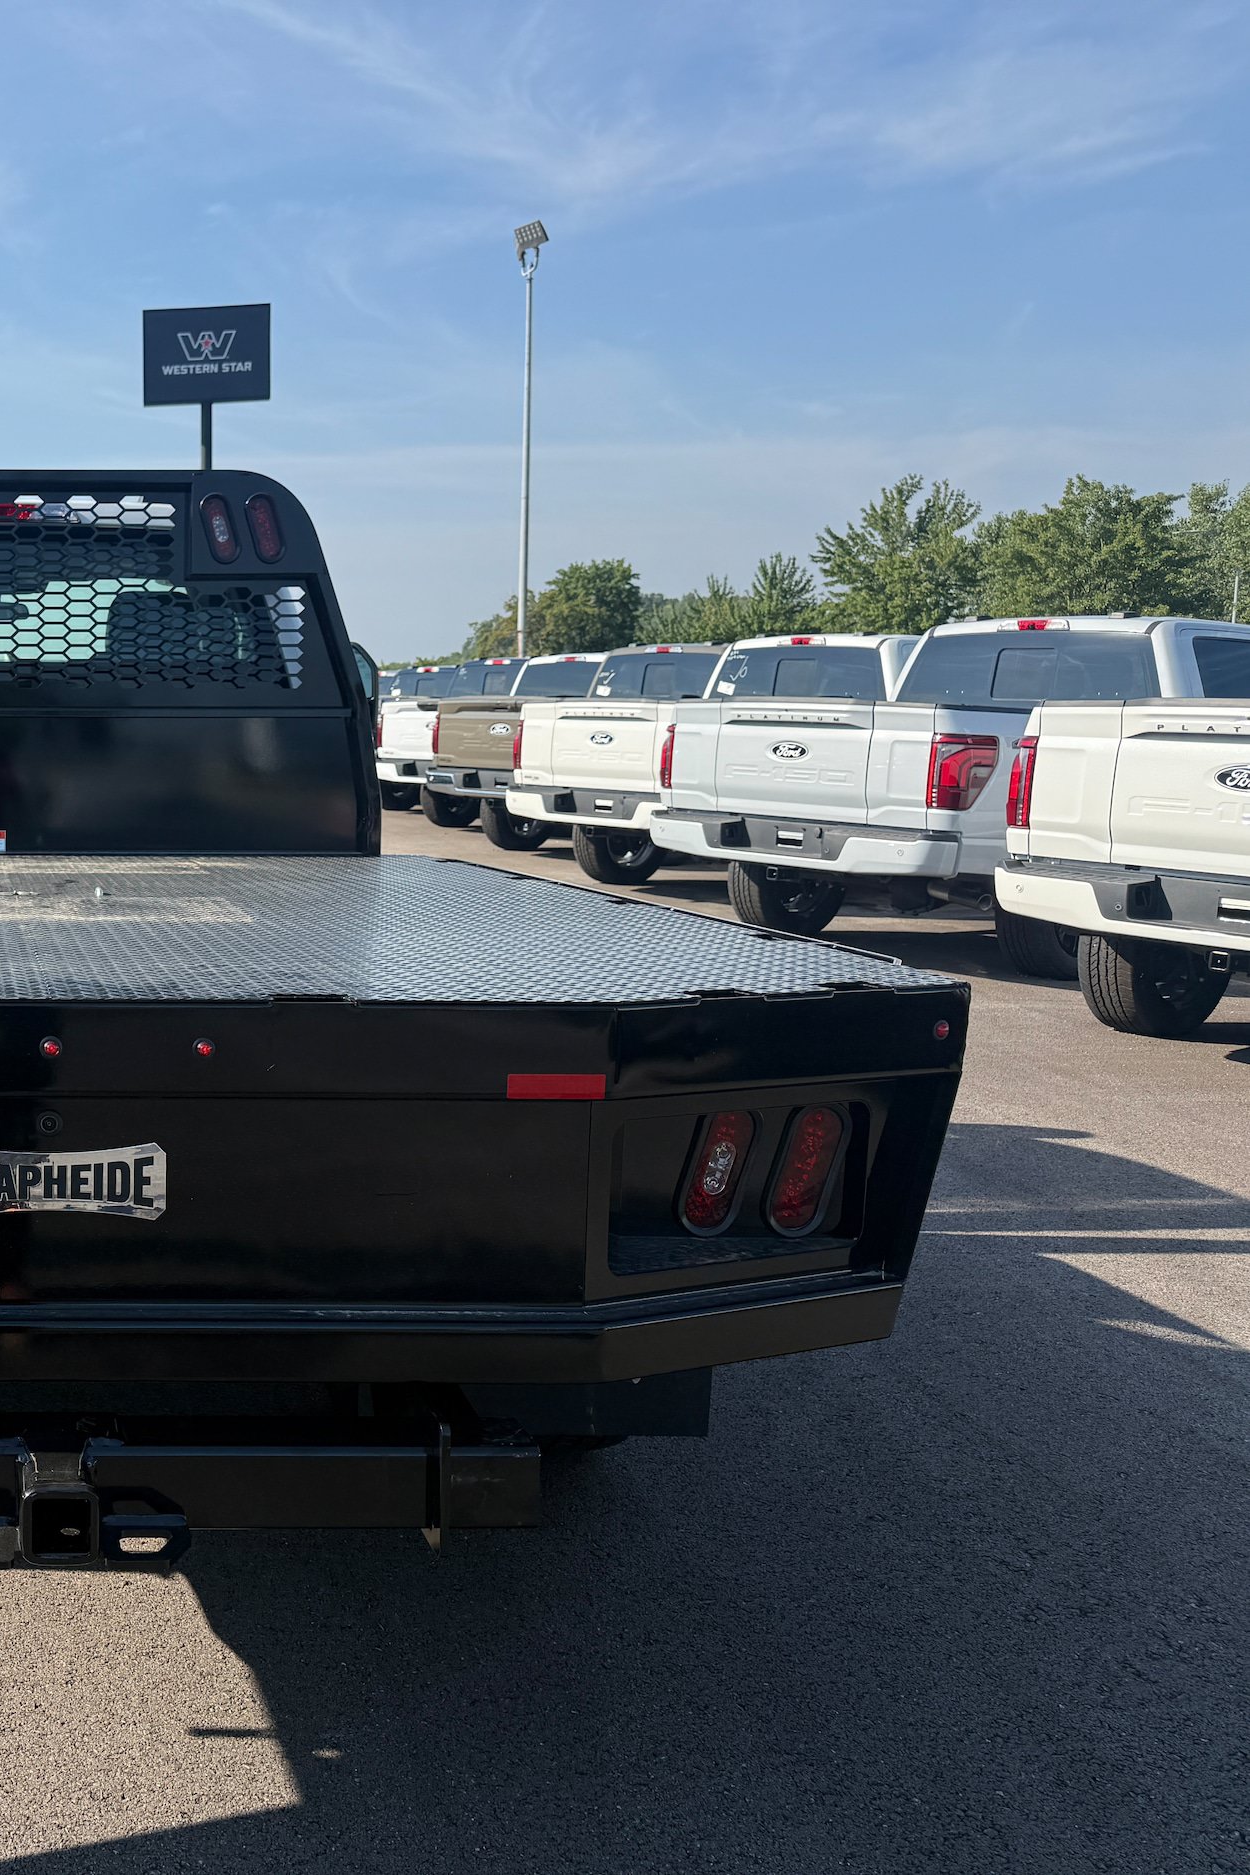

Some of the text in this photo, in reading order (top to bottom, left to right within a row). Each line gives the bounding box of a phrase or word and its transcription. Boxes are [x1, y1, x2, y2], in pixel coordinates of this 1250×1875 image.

[162, 362, 252, 375] WESTERN STAR
[775, 744, 802, 758] Ford
[1225, 769, 1250, 789] Fo
